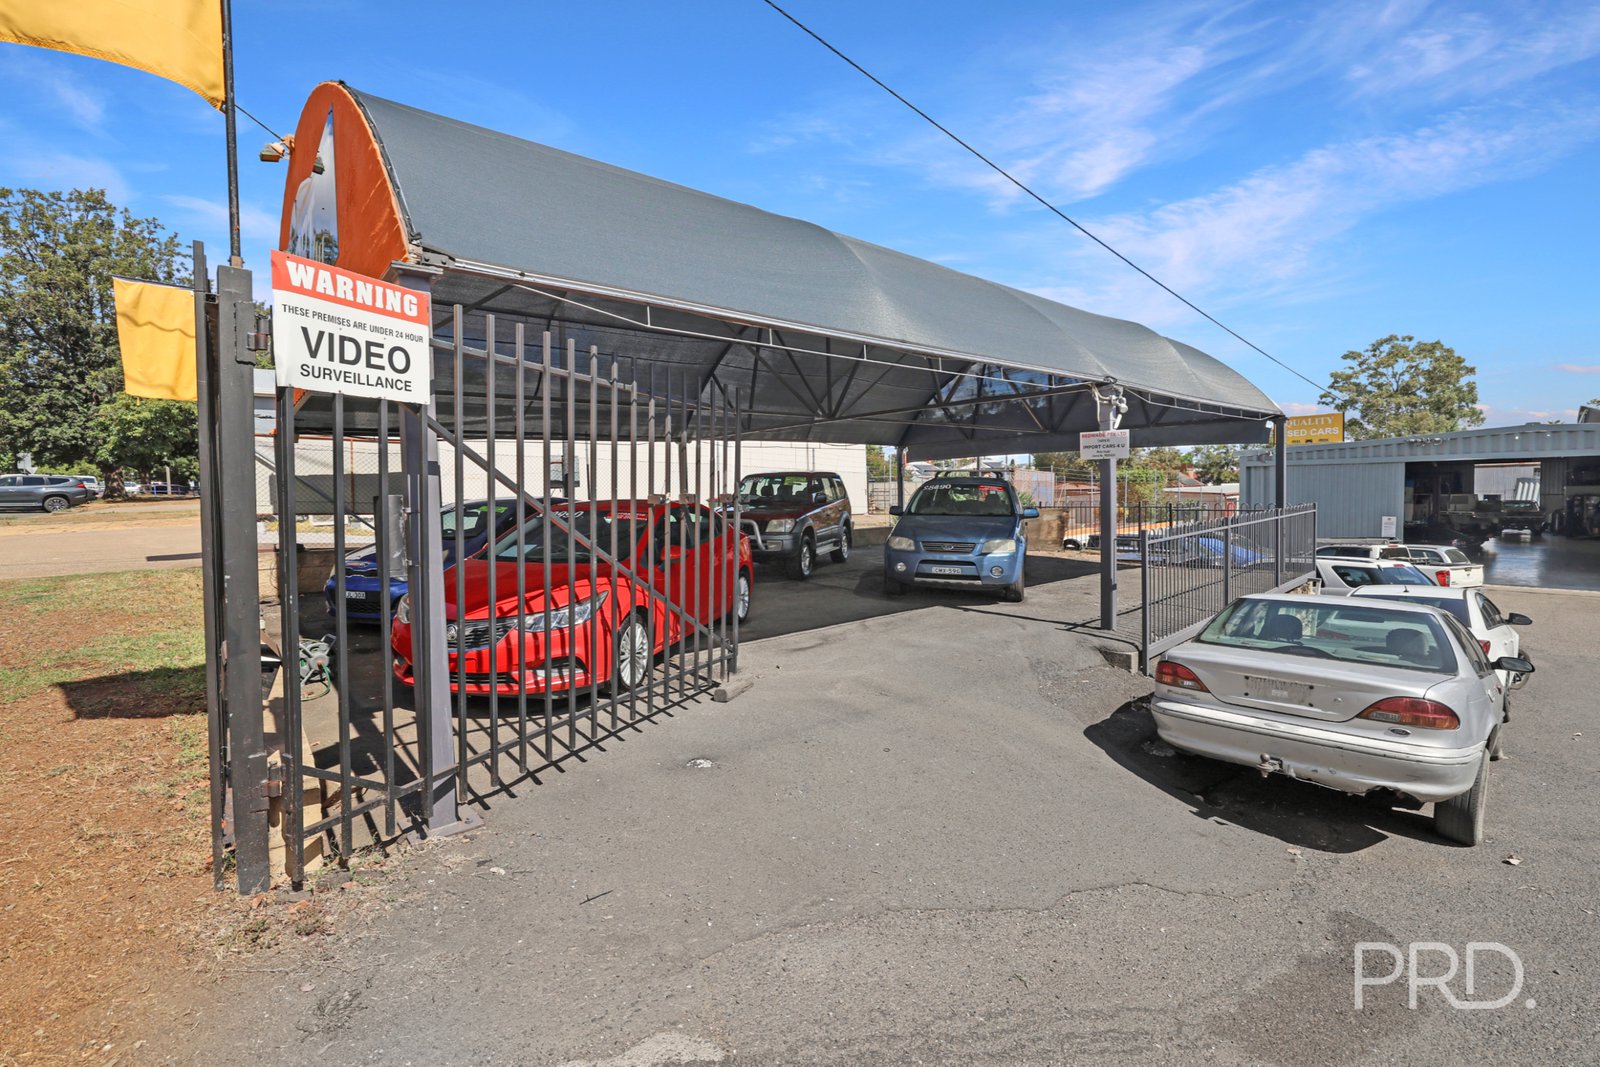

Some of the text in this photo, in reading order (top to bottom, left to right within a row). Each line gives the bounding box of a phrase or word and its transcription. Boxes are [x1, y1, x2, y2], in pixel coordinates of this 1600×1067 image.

[286, 260, 418, 317] WARNING
[282, 304, 424, 343] THESE PREMISES ARE UNDER 24 HOUR
[300, 325, 411, 375] VIDEO
[300, 363, 413, 392] SURVEILLANCE
[1287, 426, 1340, 437] SED CARS
